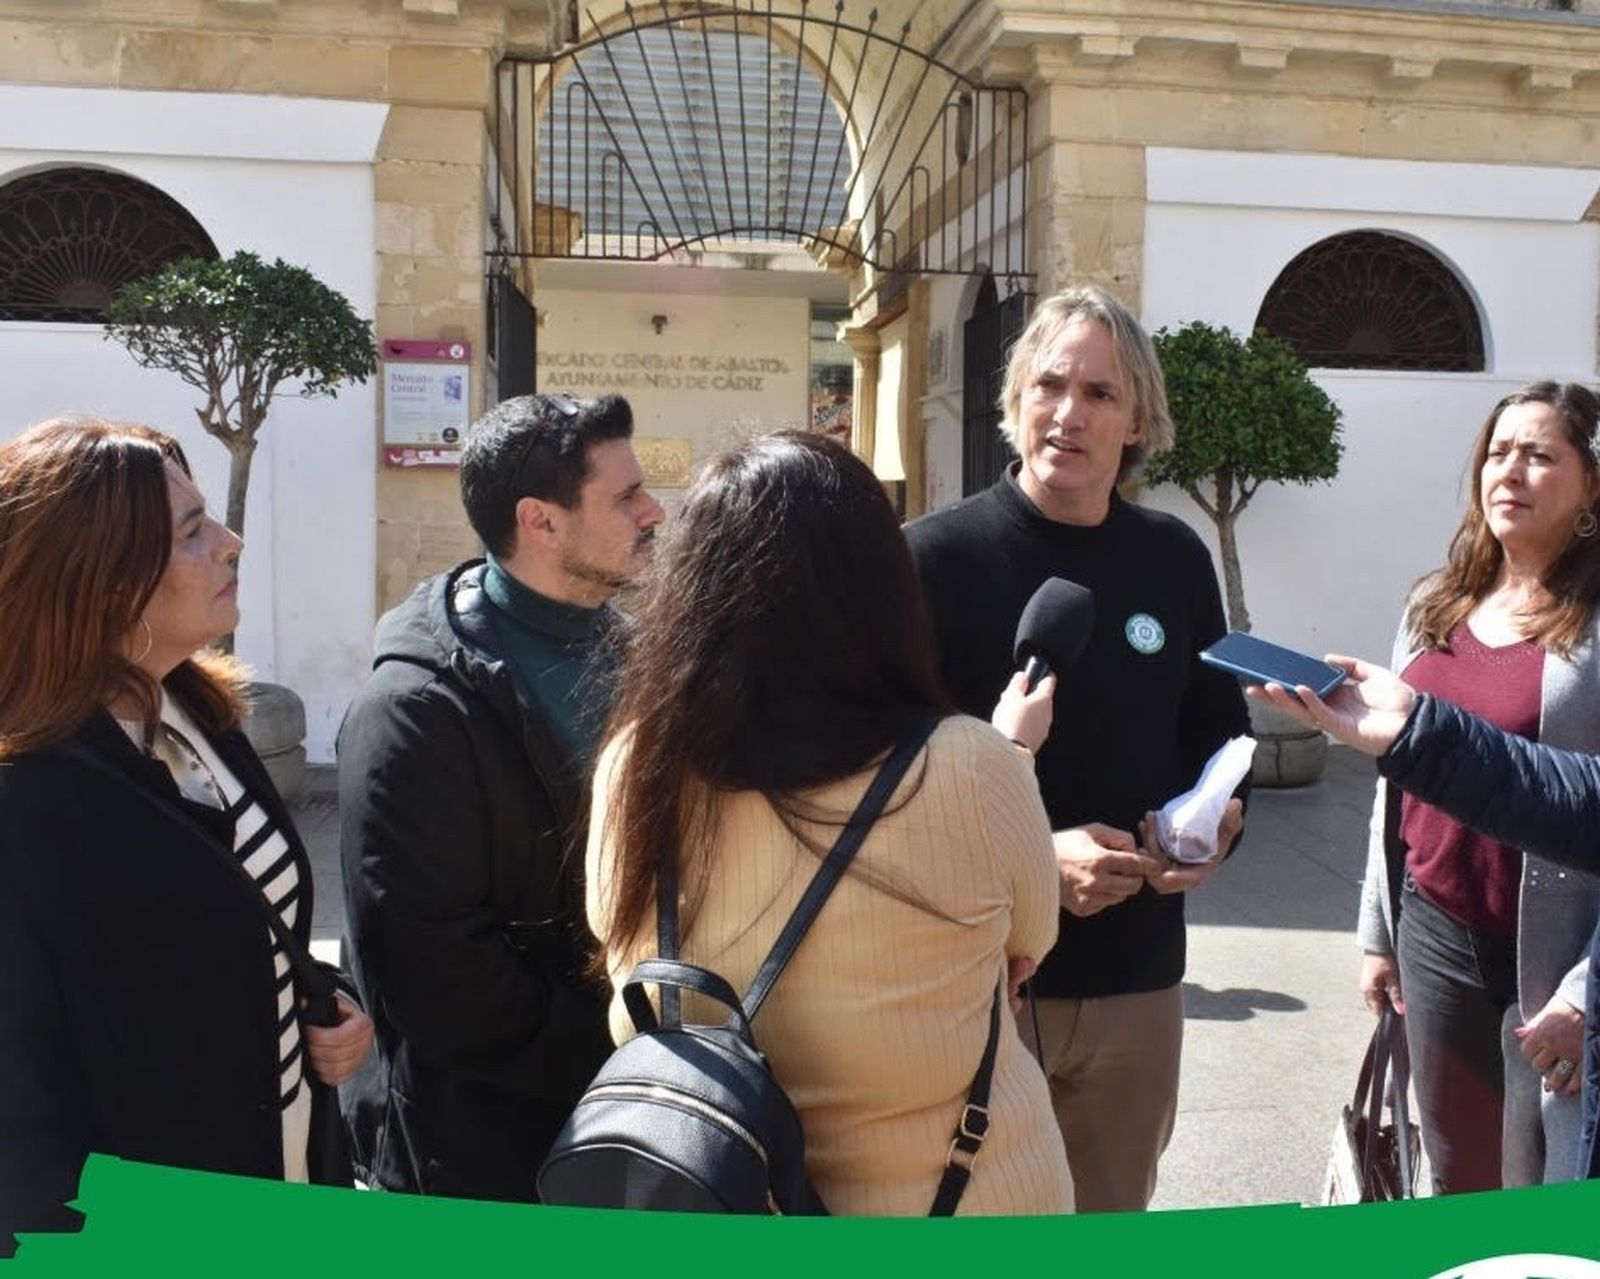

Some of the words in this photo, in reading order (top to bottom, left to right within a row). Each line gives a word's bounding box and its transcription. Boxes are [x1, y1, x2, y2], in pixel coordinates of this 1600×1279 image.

[537, 352, 606, 367] ERCADO
[689, 355, 710, 370] DE
[391, 373, 434, 384] Mercado
[686, 375, 708, 389] DE
[391, 384, 426, 393] Central
